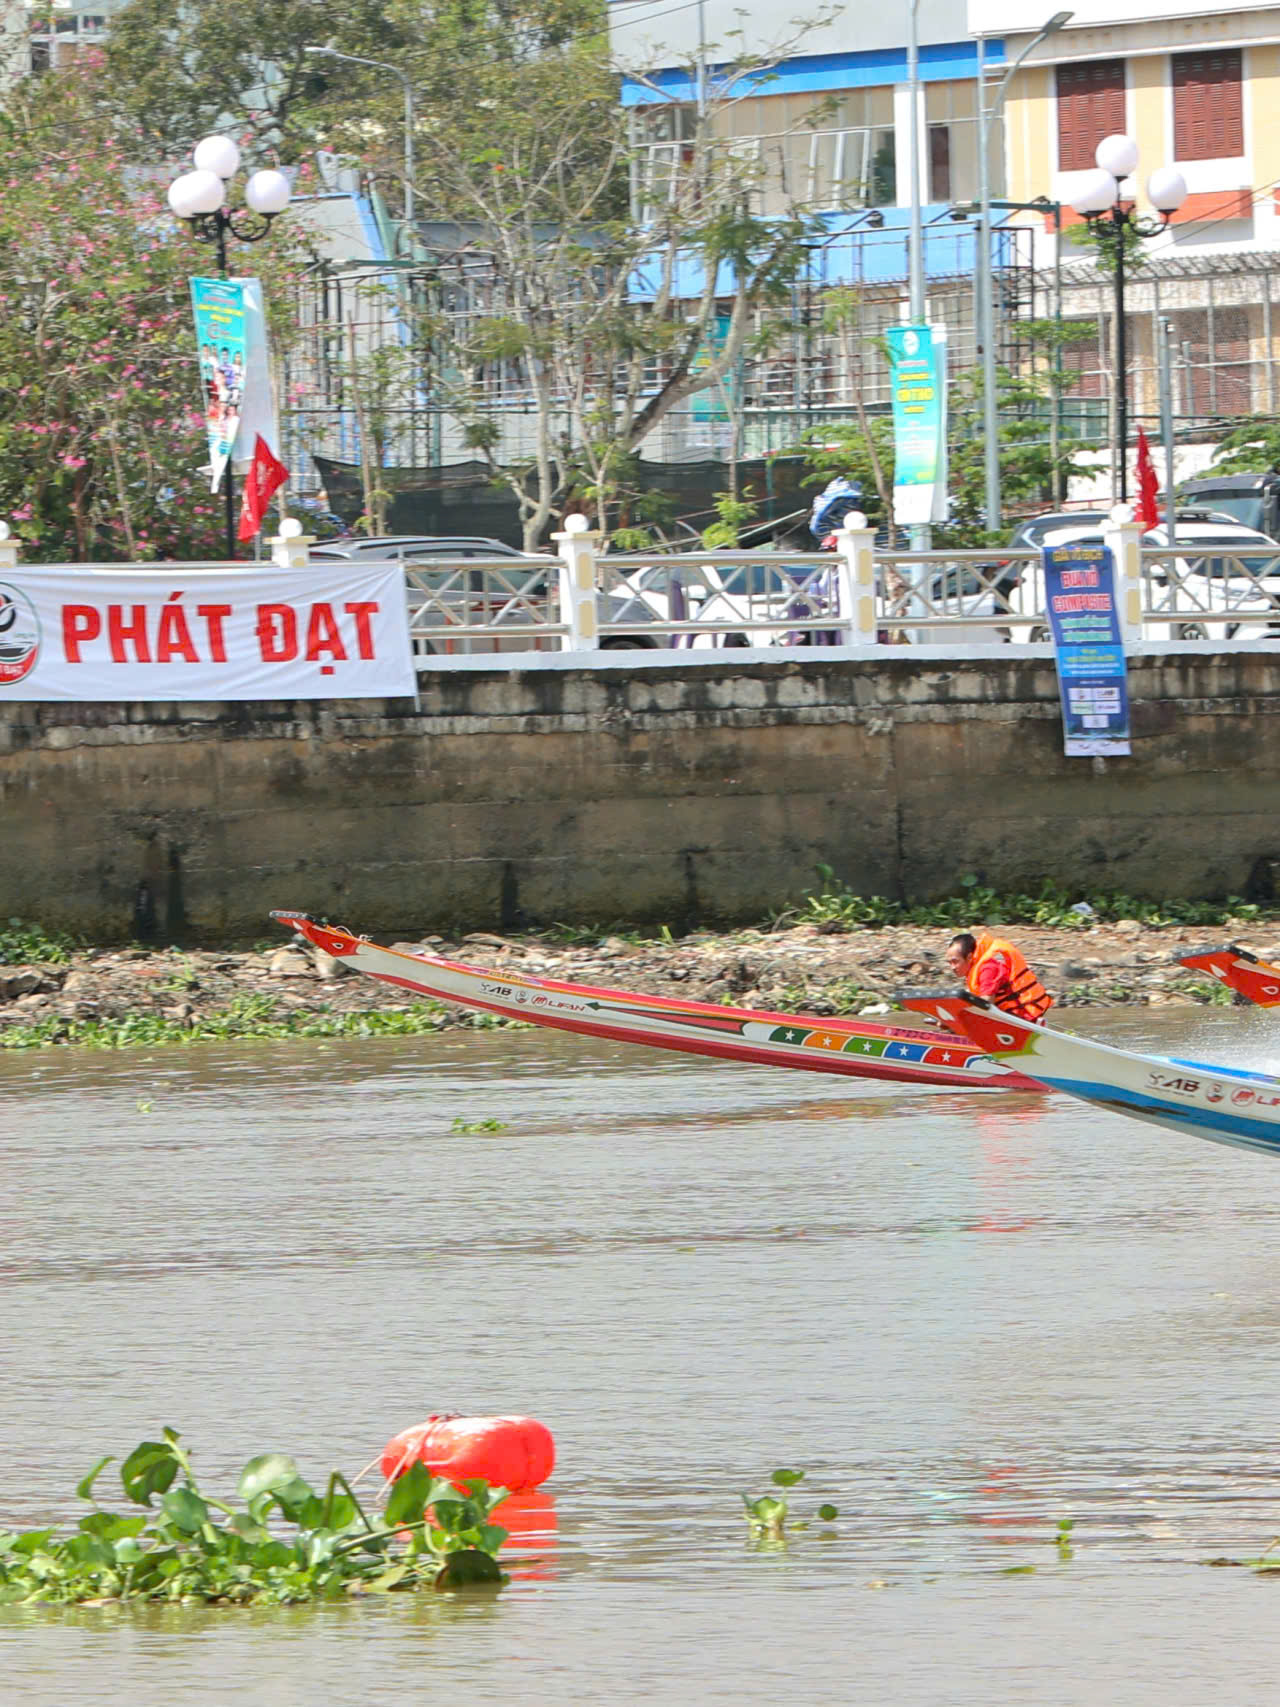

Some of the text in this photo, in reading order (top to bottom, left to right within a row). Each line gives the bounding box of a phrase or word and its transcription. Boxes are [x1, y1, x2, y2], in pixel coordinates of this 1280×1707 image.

[61, 591, 379, 675] PHÁT ĐẠT
[548, 1000, 586, 1012] LIFAN
